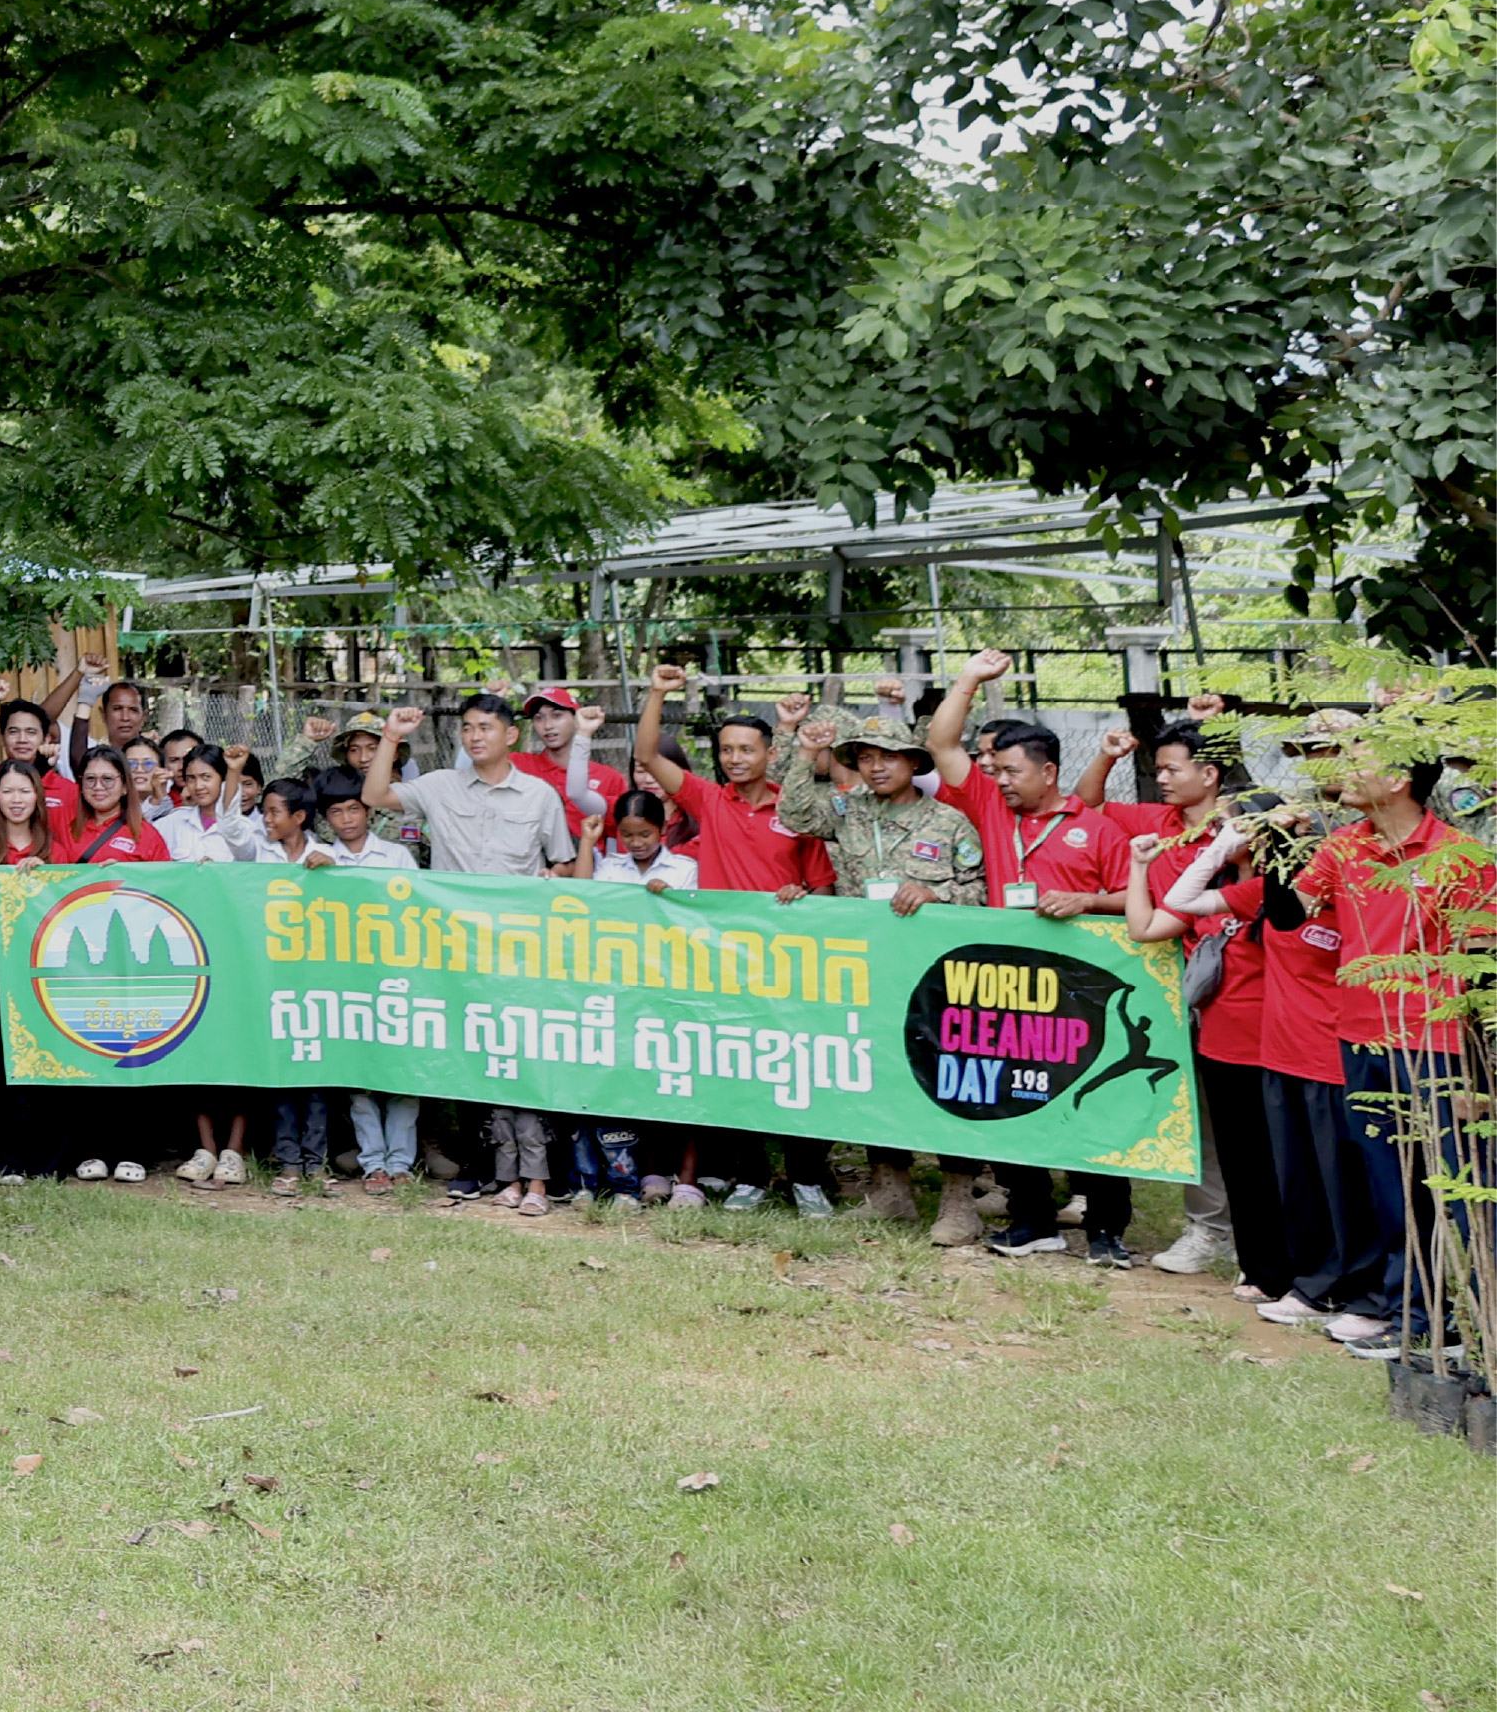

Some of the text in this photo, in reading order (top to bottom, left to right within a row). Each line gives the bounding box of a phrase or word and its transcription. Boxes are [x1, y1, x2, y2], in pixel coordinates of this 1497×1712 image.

[944, 960, 1059, 1013] WORLD
[270, 978, 873, 1109] ស្អាតទឹក ស្អាតដី ស្អាតខ្យល់
[940, 1006, 1089, 1064] CLEANUP
[937, 1054, 1004, 1104] DAY
[1011, 1069, 1048, 1091] 198
